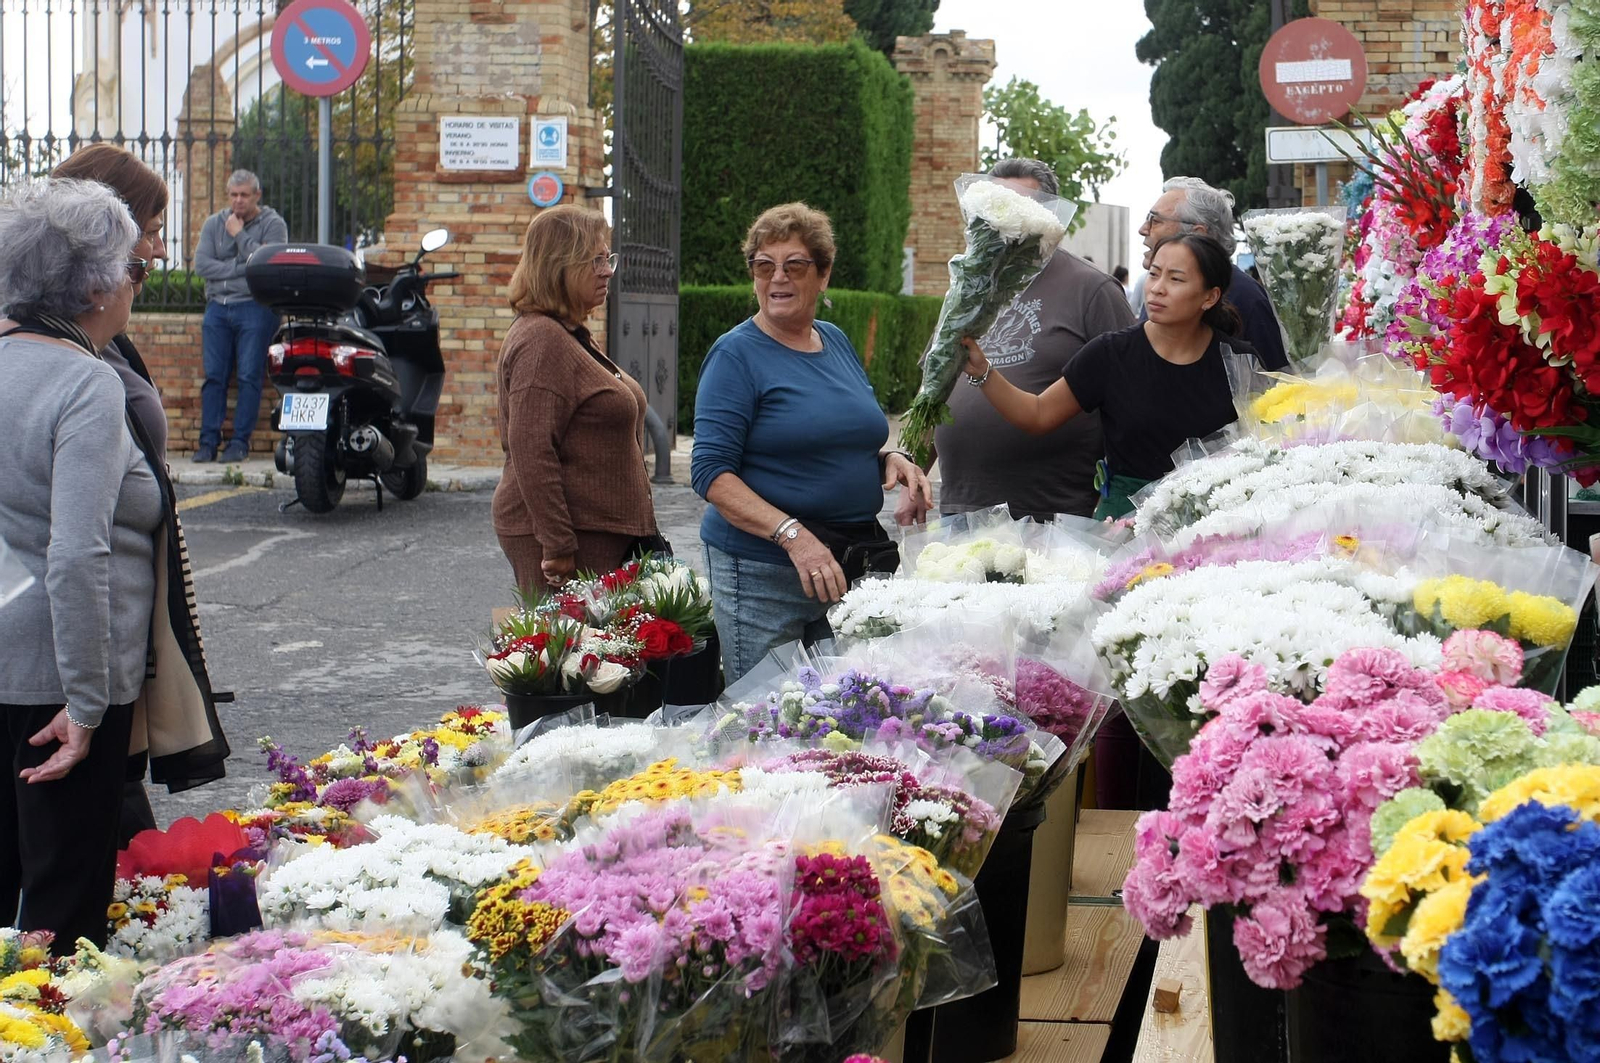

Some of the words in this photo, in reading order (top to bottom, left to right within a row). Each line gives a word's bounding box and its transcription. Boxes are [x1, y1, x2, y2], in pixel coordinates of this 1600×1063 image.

[303, 36, 309, 45] 3
[310, 36, 342, 46] METROS
[1286, 84, 1344, 96] EXCEPTO
[445, 121, 474, 129] HORARIO
[476, 121, 485, 129] DE
[489, 121, 514, 129] VISITAS
[294, 397, 327, 410] 3437
[290, 410, 316, 422] HKR
